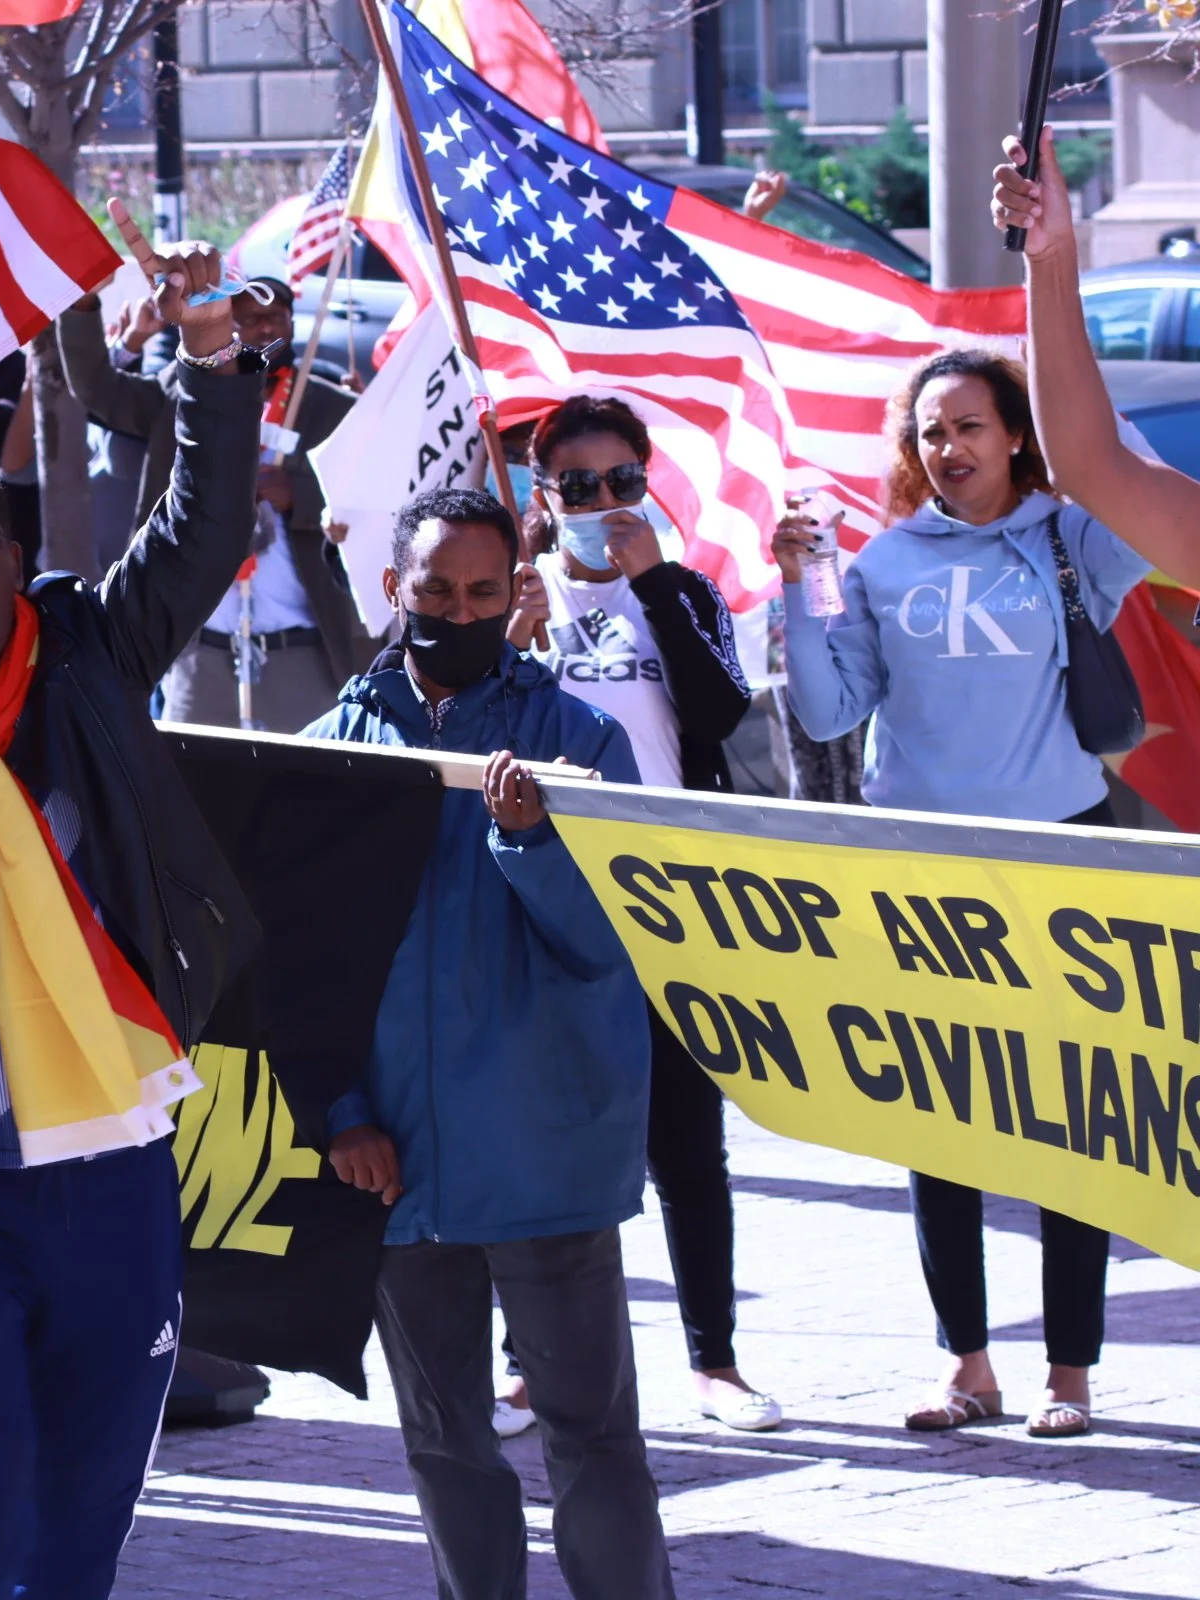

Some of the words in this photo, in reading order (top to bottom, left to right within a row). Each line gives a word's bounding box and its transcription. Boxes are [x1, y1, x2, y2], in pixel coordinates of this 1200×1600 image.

[897, 565, 1034, 659] CK
[608, 854, 841, 960] STOP
[870, 890, 1033, 990] AIR
[663, 980, 810, 1093] ON
